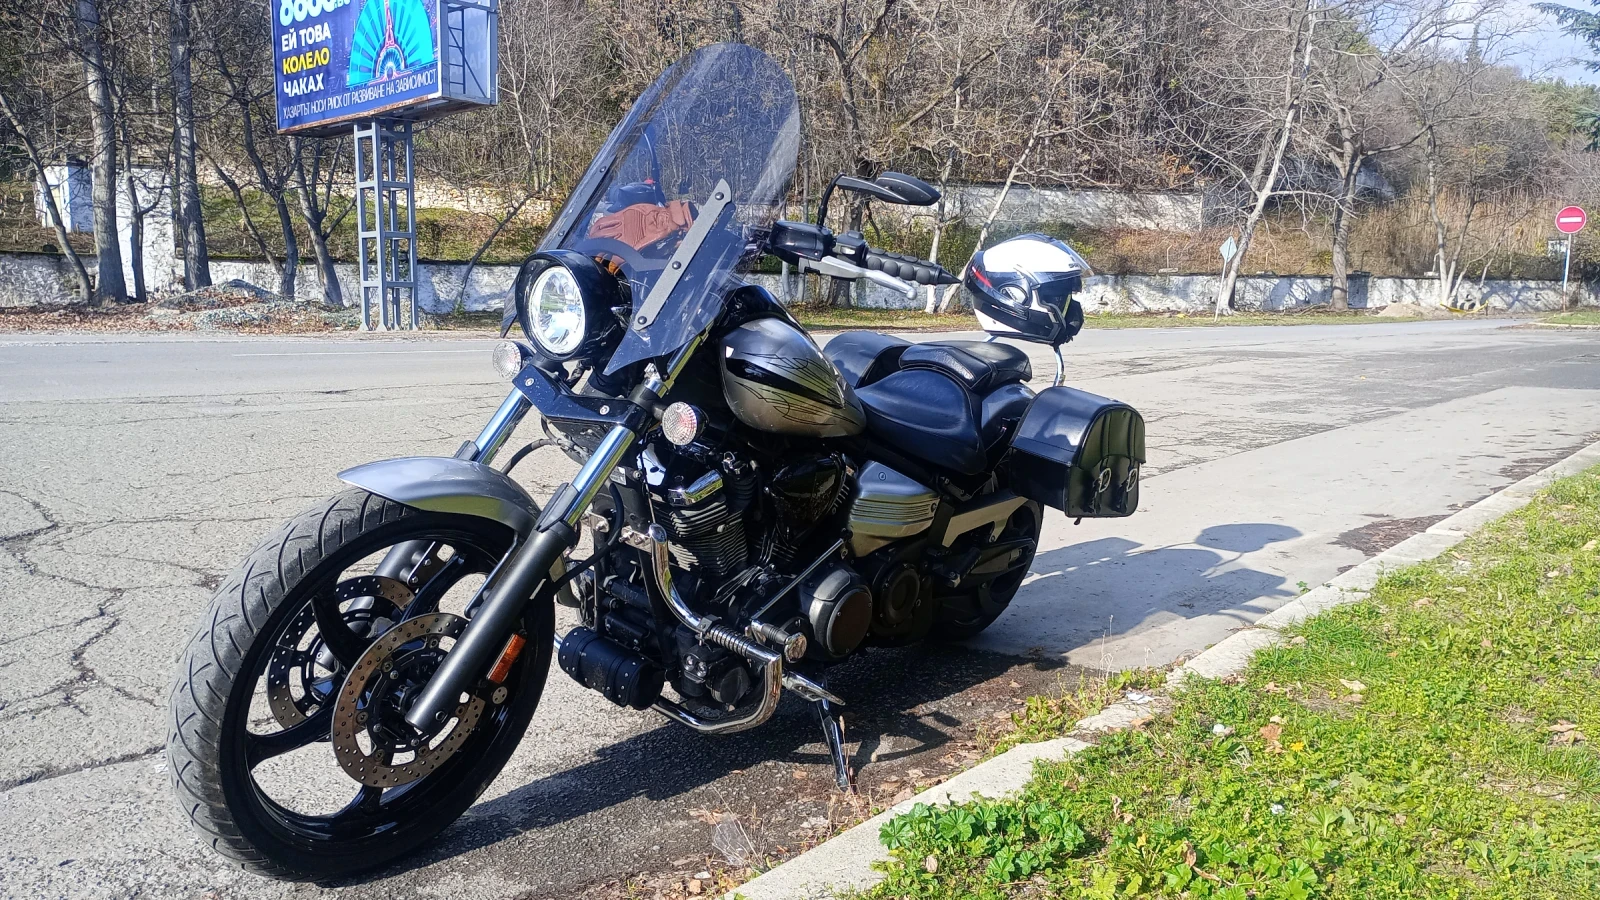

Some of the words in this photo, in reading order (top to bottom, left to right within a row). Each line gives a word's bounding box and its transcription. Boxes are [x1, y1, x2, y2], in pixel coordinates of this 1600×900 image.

[281, 28, 297, 52] ЕЙ
[299, 22, 331, 47] ТОВА
[283, 47, 330, 75] КОЛЕЛО
[283, 73, 325, 97] ЧАКАХ
[283, 102, 310, 119] ХАЗАРТЪТ
[311, 98, 327, 114] НОСИ
[328, 94, 342, 111] РИСК
[343, 92, 351, 107] ОТ
[352, 84, 385, 105] РАЗВИВАНЕ
[386, 80, 395, 96] НА
[396, 69, 437, 94] ЗАВИСИМОСТ
